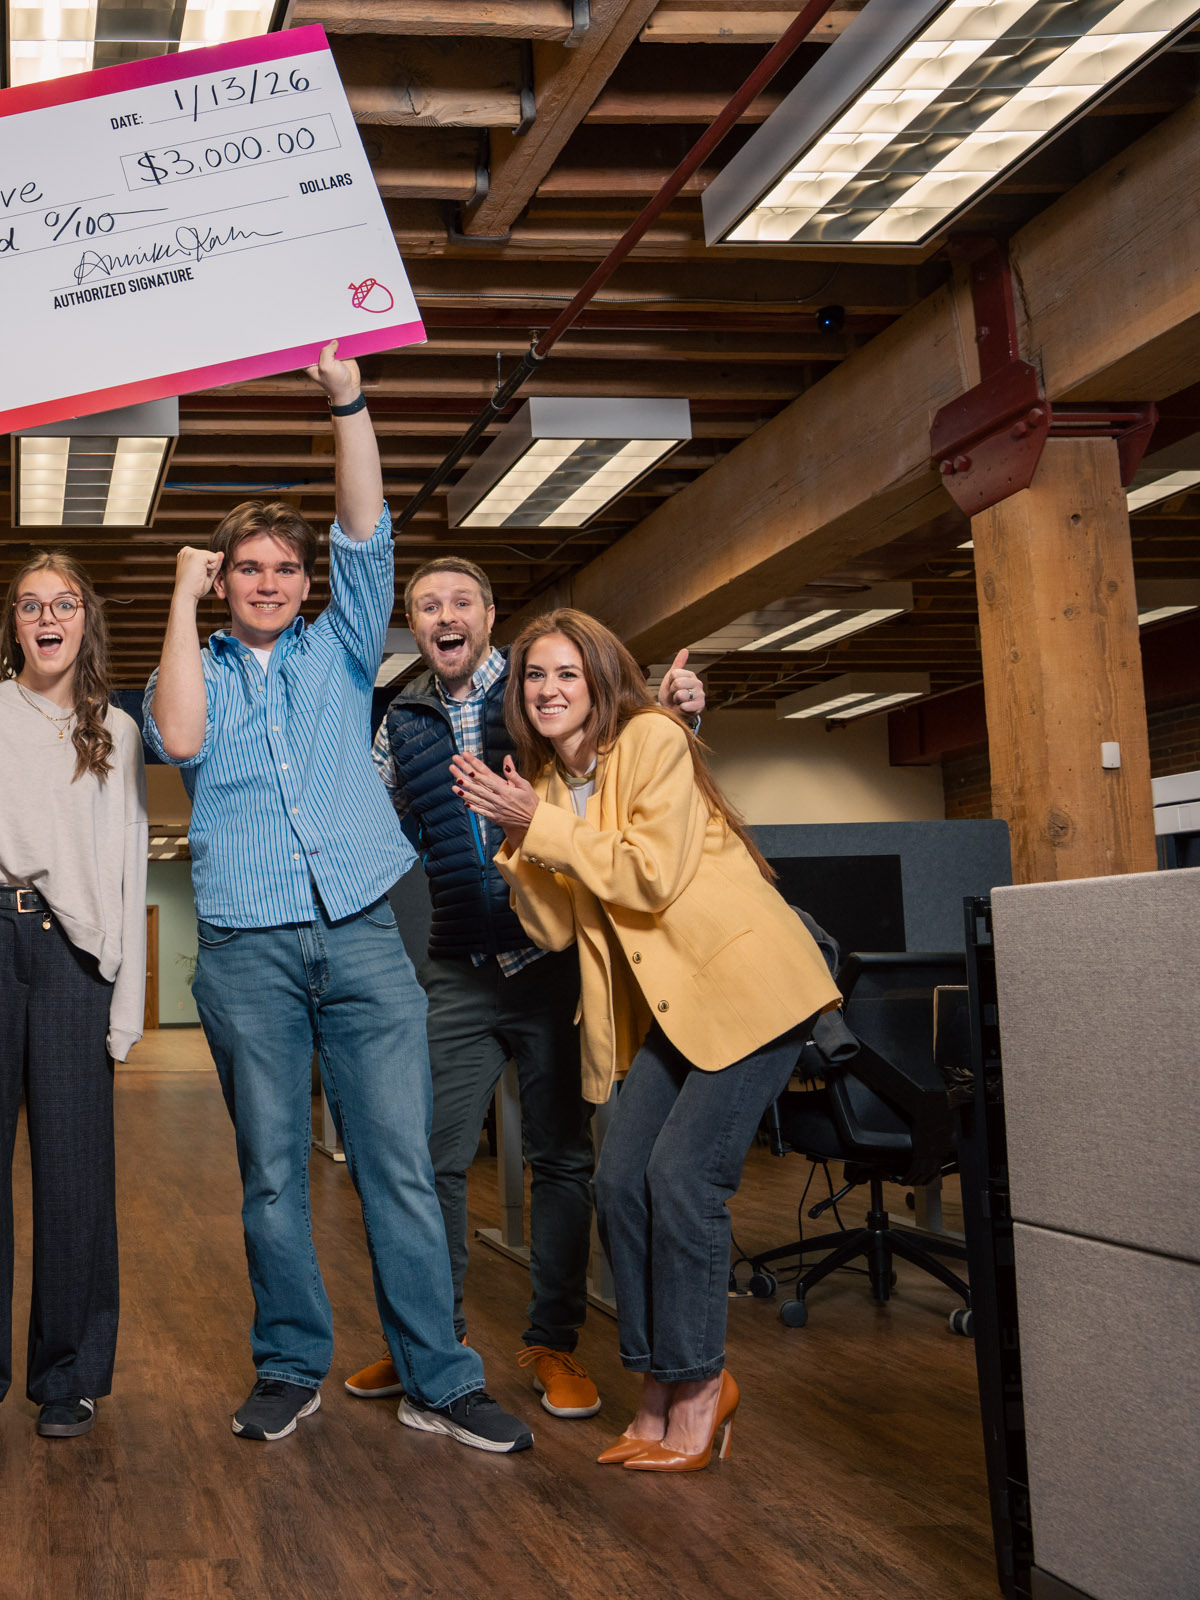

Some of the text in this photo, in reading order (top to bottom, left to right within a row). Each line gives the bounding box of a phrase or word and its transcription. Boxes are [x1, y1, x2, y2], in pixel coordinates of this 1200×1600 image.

[174, 68, 310, 122] 1/13/26
[110, 113, 143, 131] DATE:
[137, 126, 315, 186] $3,000.00
[299, 172, 353, 196] DOLLARS
[53, 267, 194, 309] AUTHORIZED SIGNATURE
